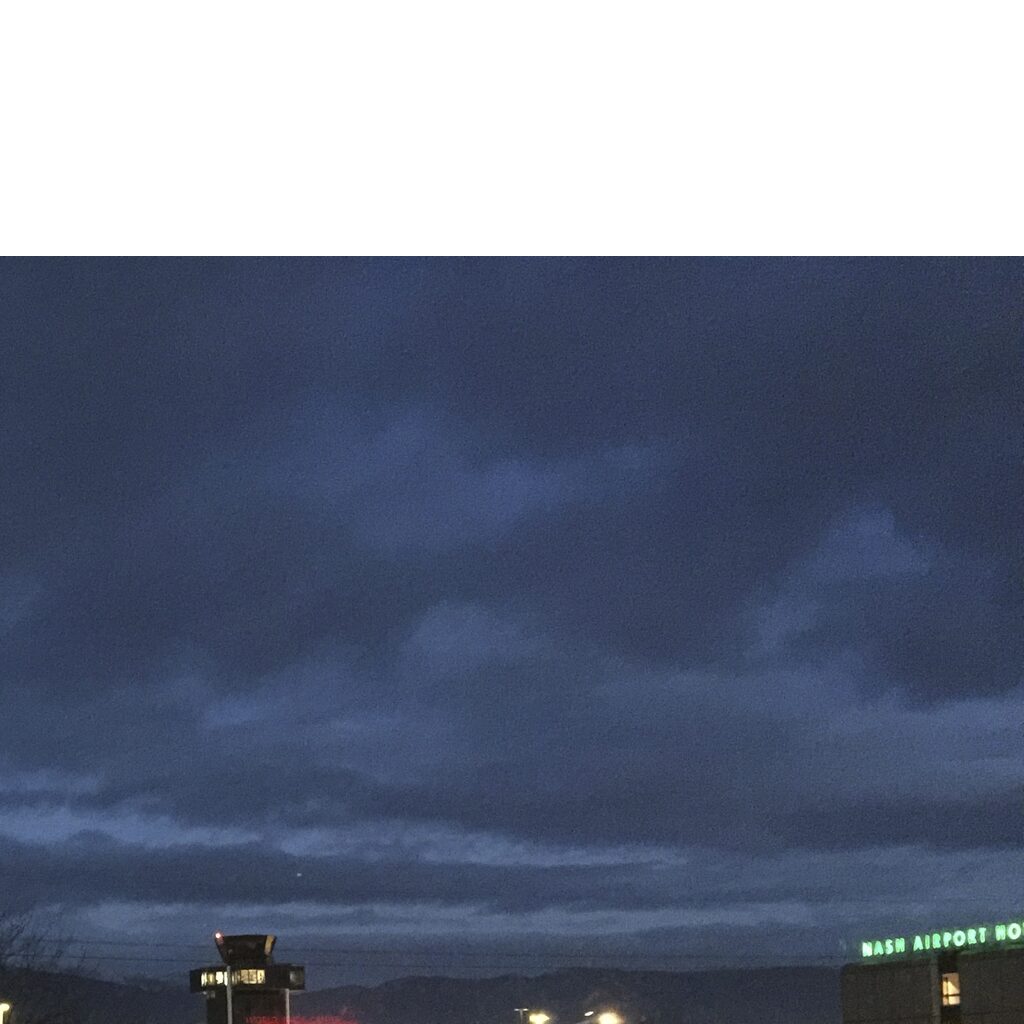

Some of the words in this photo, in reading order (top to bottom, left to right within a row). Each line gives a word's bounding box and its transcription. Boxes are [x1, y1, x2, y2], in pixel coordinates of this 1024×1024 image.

[862, 938, 906, 957] NASH
[913, 927, 987, 951] AIRPORT
[994, 922, 1024, 941] HO
